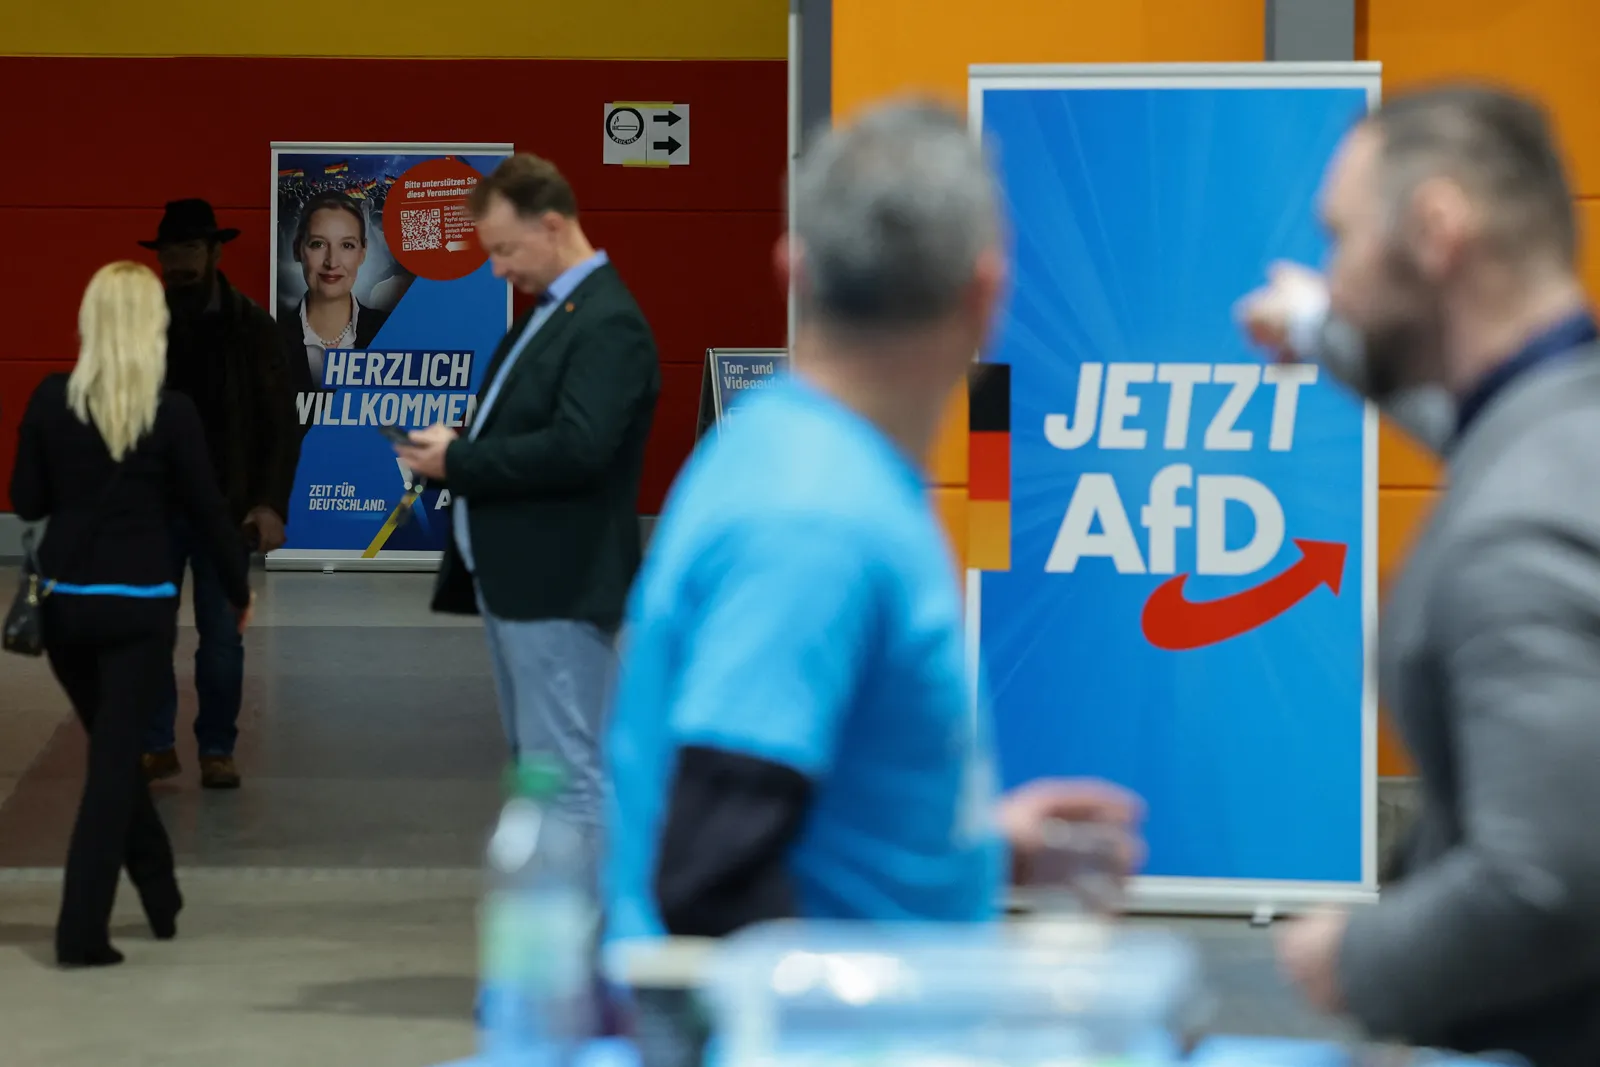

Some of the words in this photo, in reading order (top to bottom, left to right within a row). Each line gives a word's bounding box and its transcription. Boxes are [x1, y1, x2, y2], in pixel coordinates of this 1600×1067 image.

[404, 180, 421, 189] Bitte
[422, 178, 466, 188] unterstützen
[466, 176, 478, 185] Sie
[406, 190, 426, 199] diese
[325, 351, 471, 387] HERZLICH
[722, 361, 749, 375] Ton-
[751, 361, 774, 375] und
[1044, 361, 1319, 452] JETZT
[308, 484, 333, 497] ZEIT
[334, 481, 356, 498] FÜR
[308, 498, 388, 512] DEUTSCHLAND.
[1044, 463, 1286, 576] AfD
